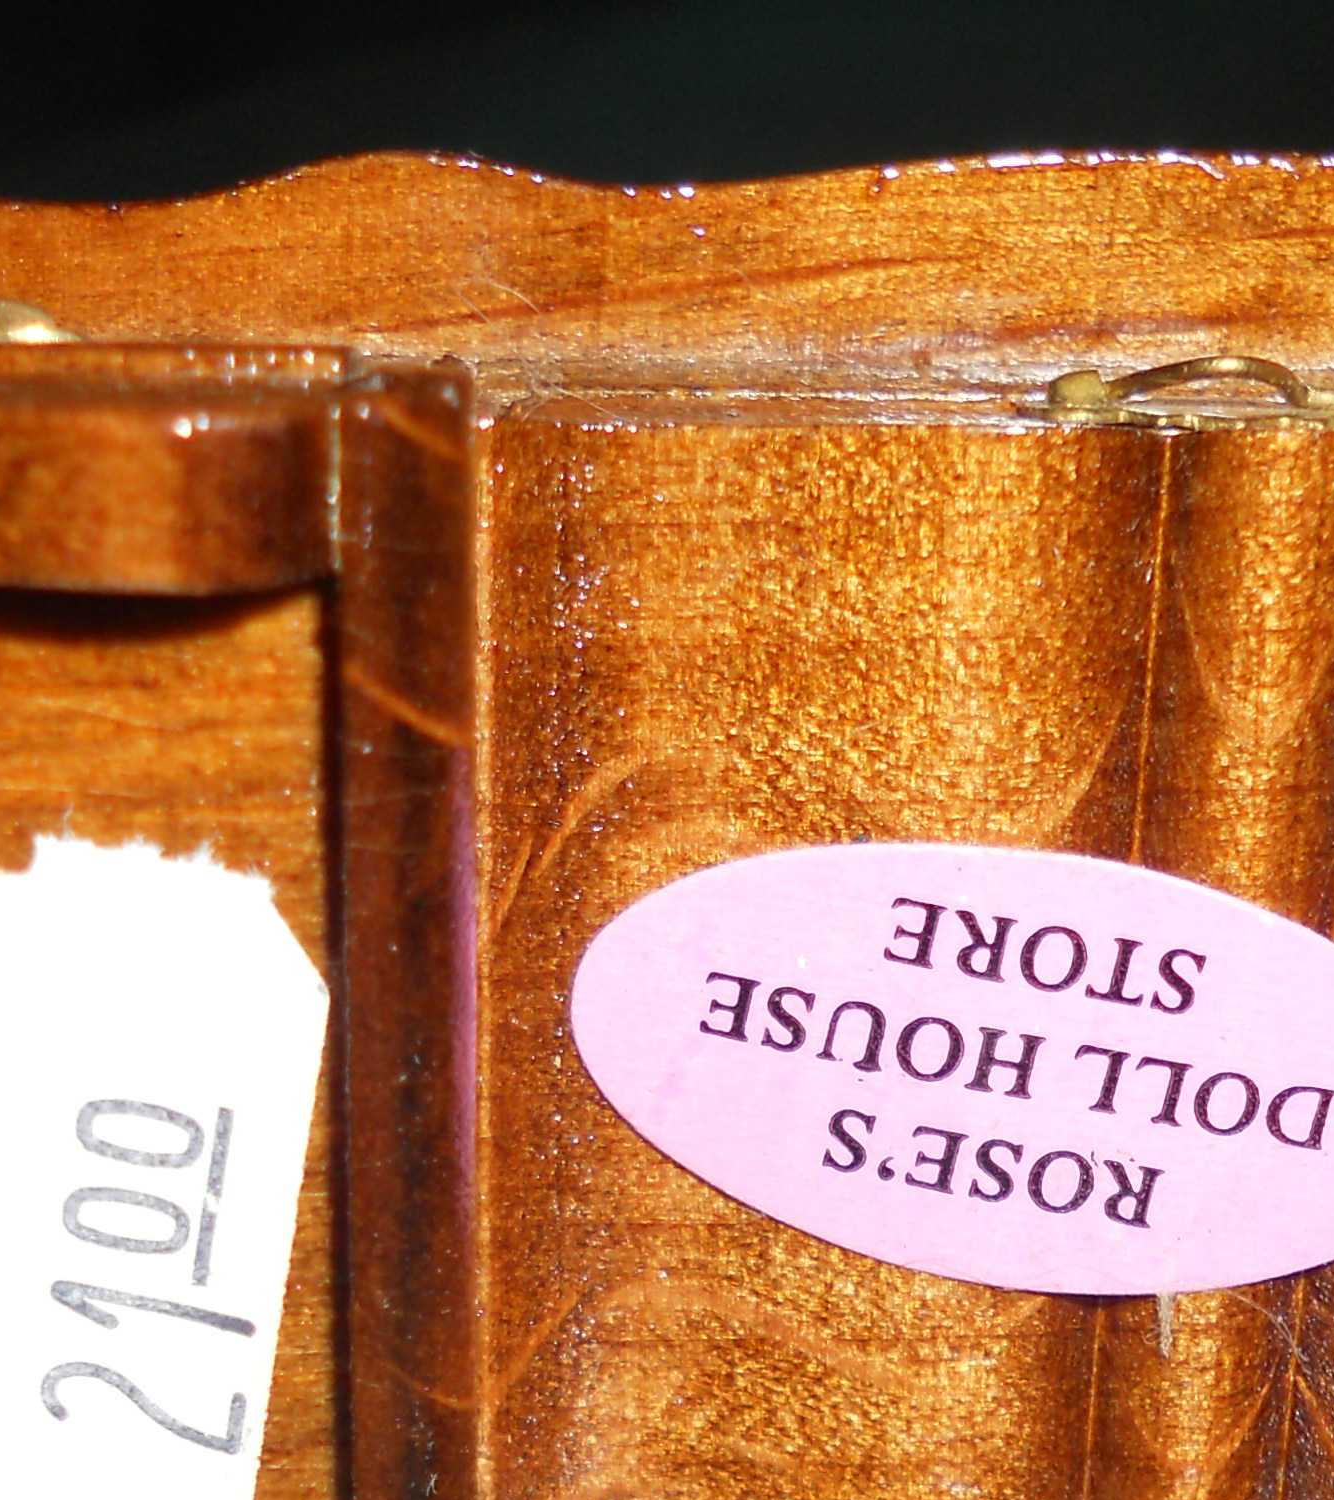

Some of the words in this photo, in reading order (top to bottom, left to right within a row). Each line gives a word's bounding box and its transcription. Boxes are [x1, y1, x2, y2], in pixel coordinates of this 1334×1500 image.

[882, 896, 1207, 1015] STORE
[698, 971, 1045, 1100] HOUSE
[822, 1108, 1165, 1230] ROSE'S
